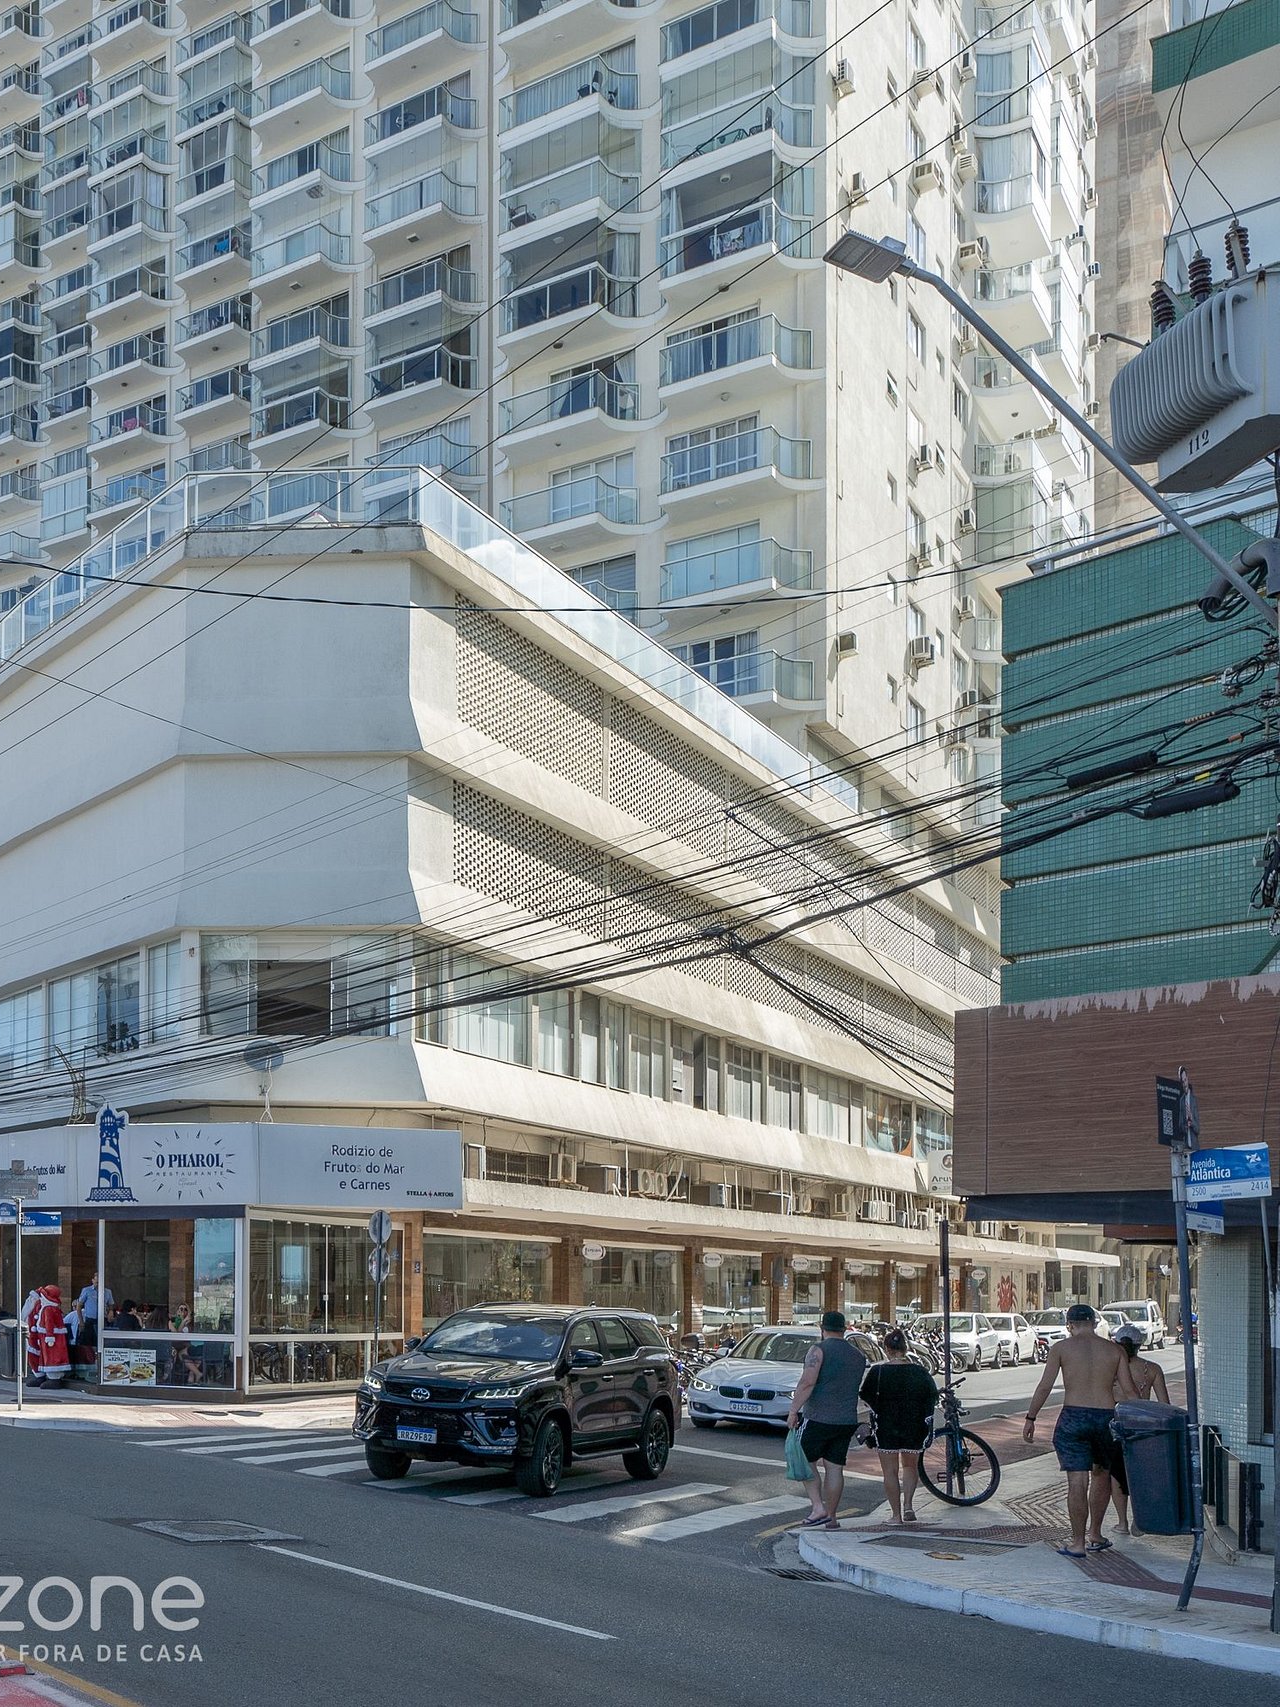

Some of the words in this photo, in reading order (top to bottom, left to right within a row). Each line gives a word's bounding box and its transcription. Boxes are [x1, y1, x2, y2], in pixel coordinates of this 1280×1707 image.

[1189, 429, 1210, 456] 112
[331, 1144, 376, 1157] Rodízio
[379, 1146, 394, 1157] de
[156, 1154, 165, 1169] O
[168, 1153, 224, 1168] PHAROL
[1191, 1158, 1216, 1169] Avenida
[56, 1164, 66, 1174] Mar
[366, 1162, 380, 1174] do
[384, 1163, 405, 1175] Mar
[1190, 1166, 1231, 1181] Atlântica
[339, 1180, 347, 1189] e
[350, 1178, 391, 1191] Carnes
[1191, 1186, 1207, 1197] 2500
[1250, 1181, 1269, 1191] 2414
[400, 1430, 433, 1442] RRZ9F82
